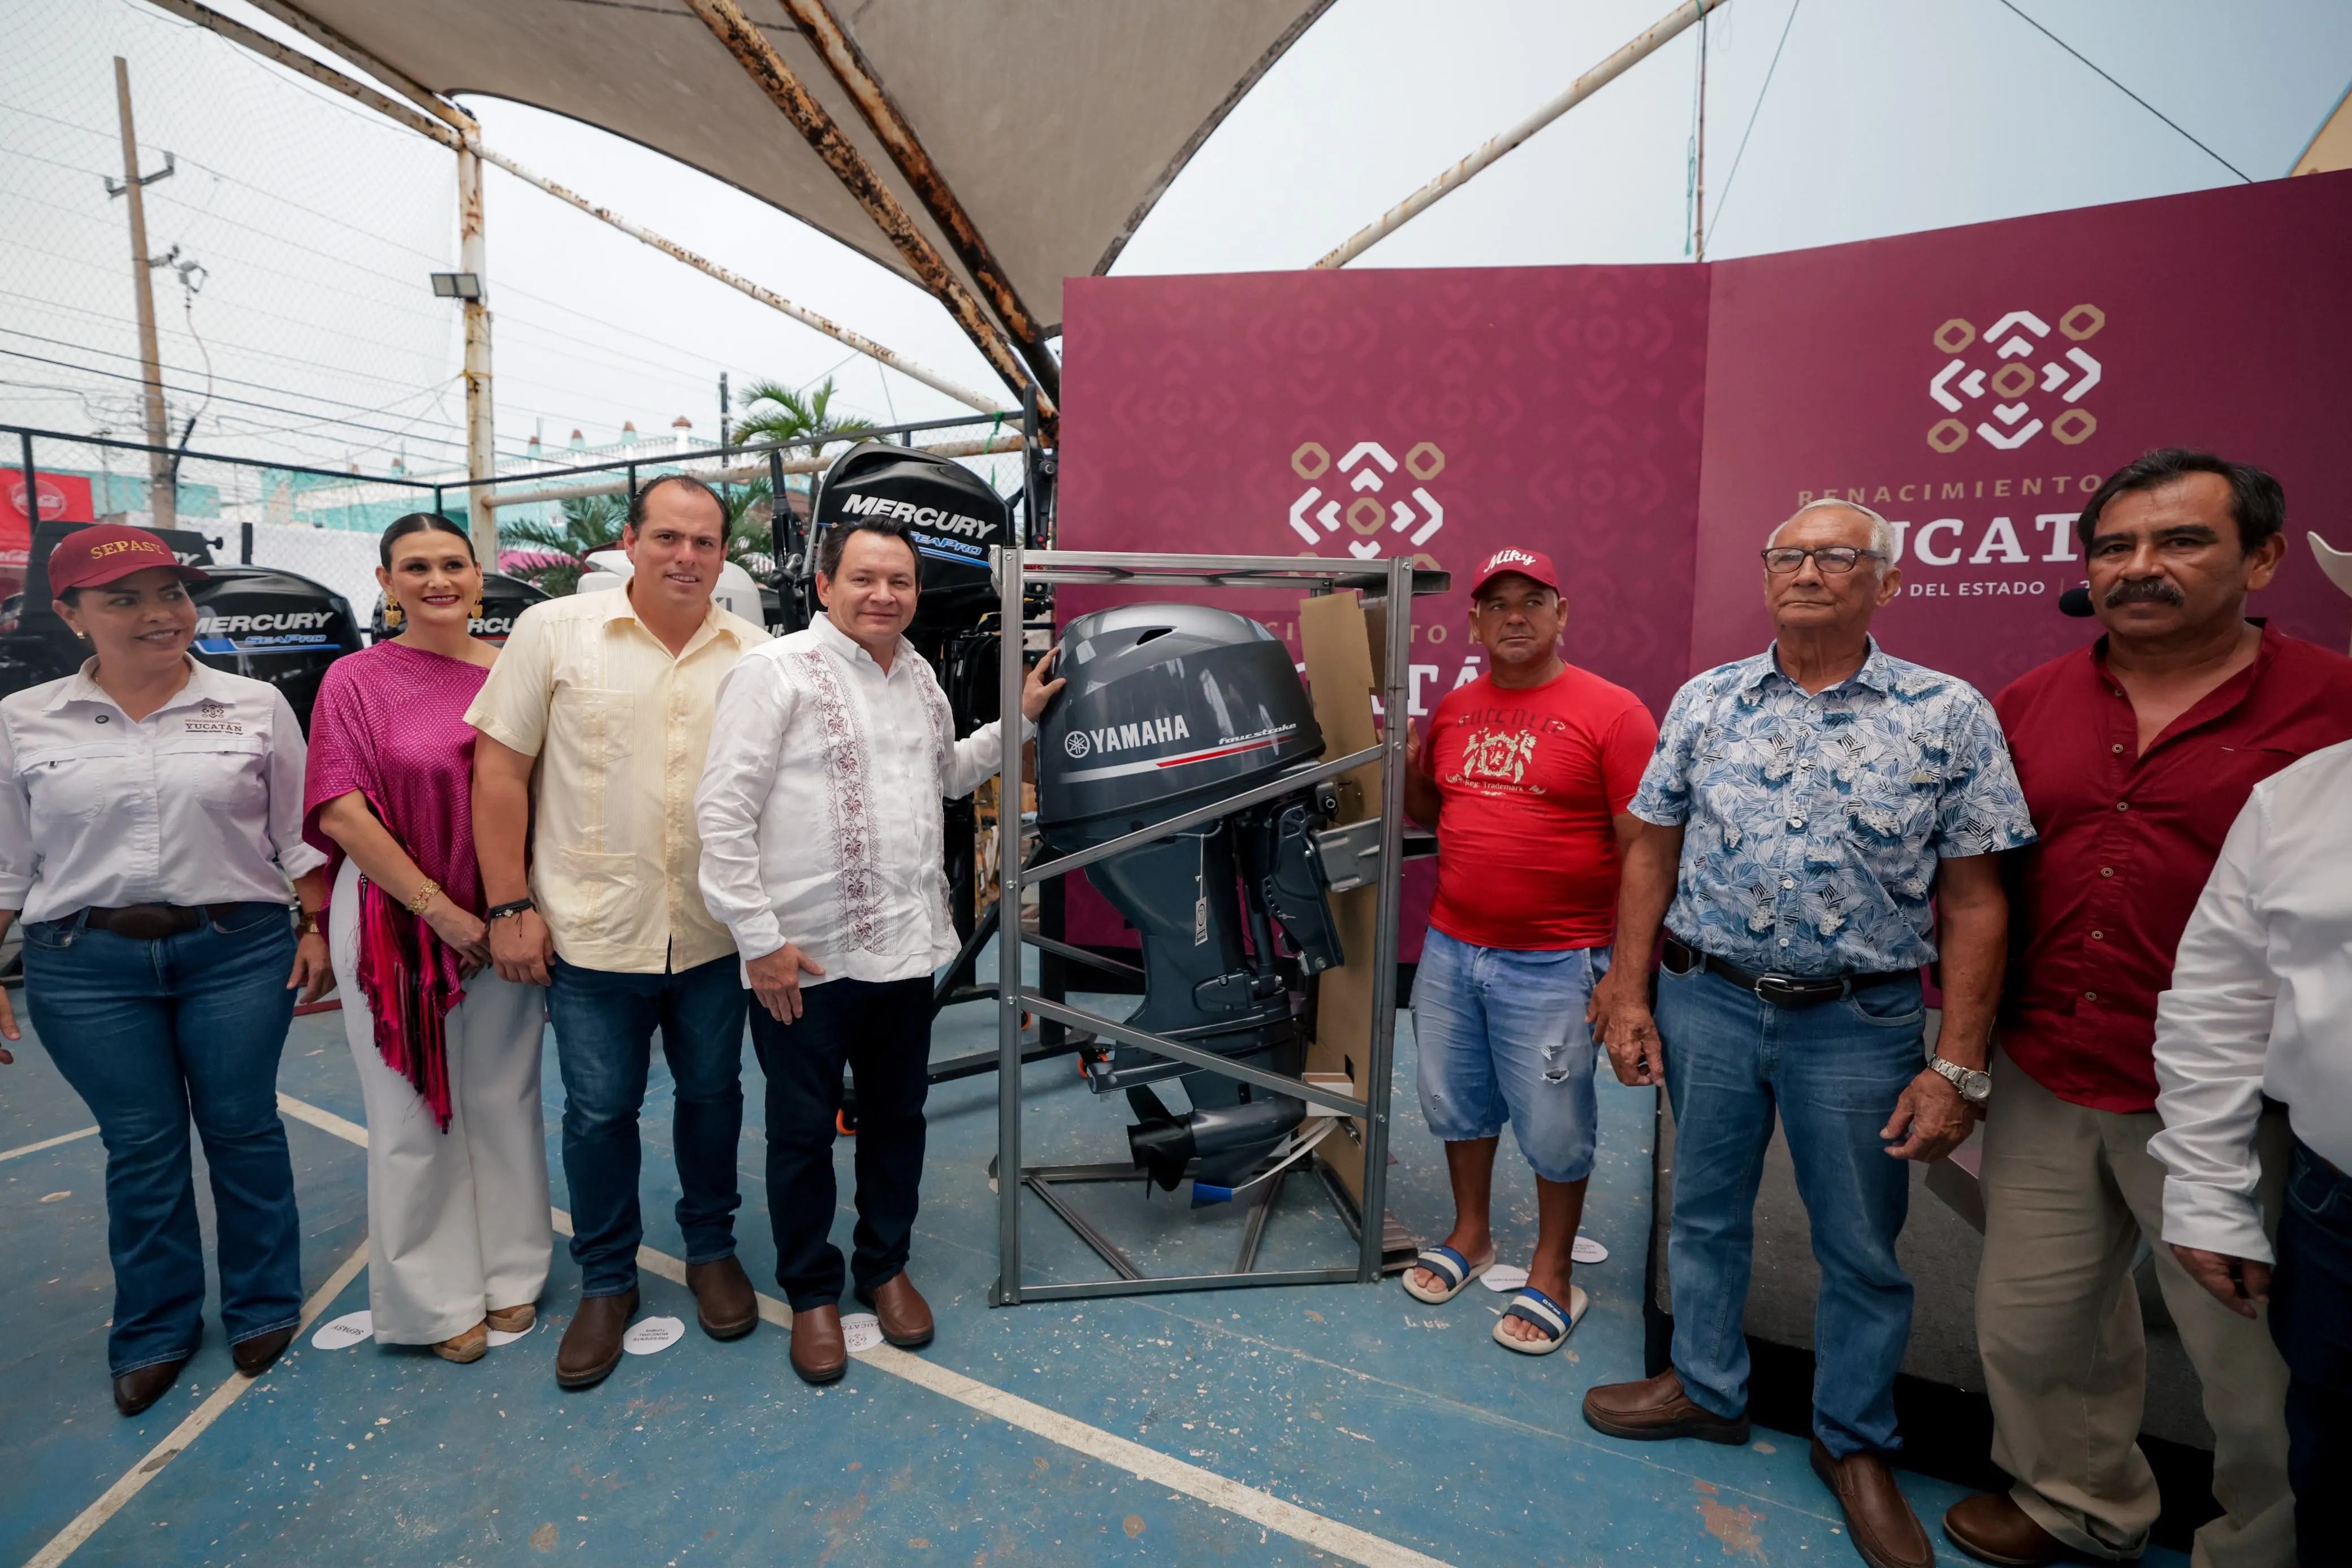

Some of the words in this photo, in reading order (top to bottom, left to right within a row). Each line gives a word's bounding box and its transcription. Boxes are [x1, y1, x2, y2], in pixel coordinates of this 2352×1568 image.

[841, 493, 998, 540] MERCURY
[89, 539, 165, 559] SEPASY
[1483, 549, 1536, 573] Miky
[1909, 583, 1951, 597] DEL
[1958, 581, 2046, 597] ESTADO
[185, 723, 243, 731] YUCATÁN
[1089, 714, 1190, 753] YAMAHA
[1483, 781, 1524, 792] Trademark
[331, 1324, 365, 1336] SEPASY
